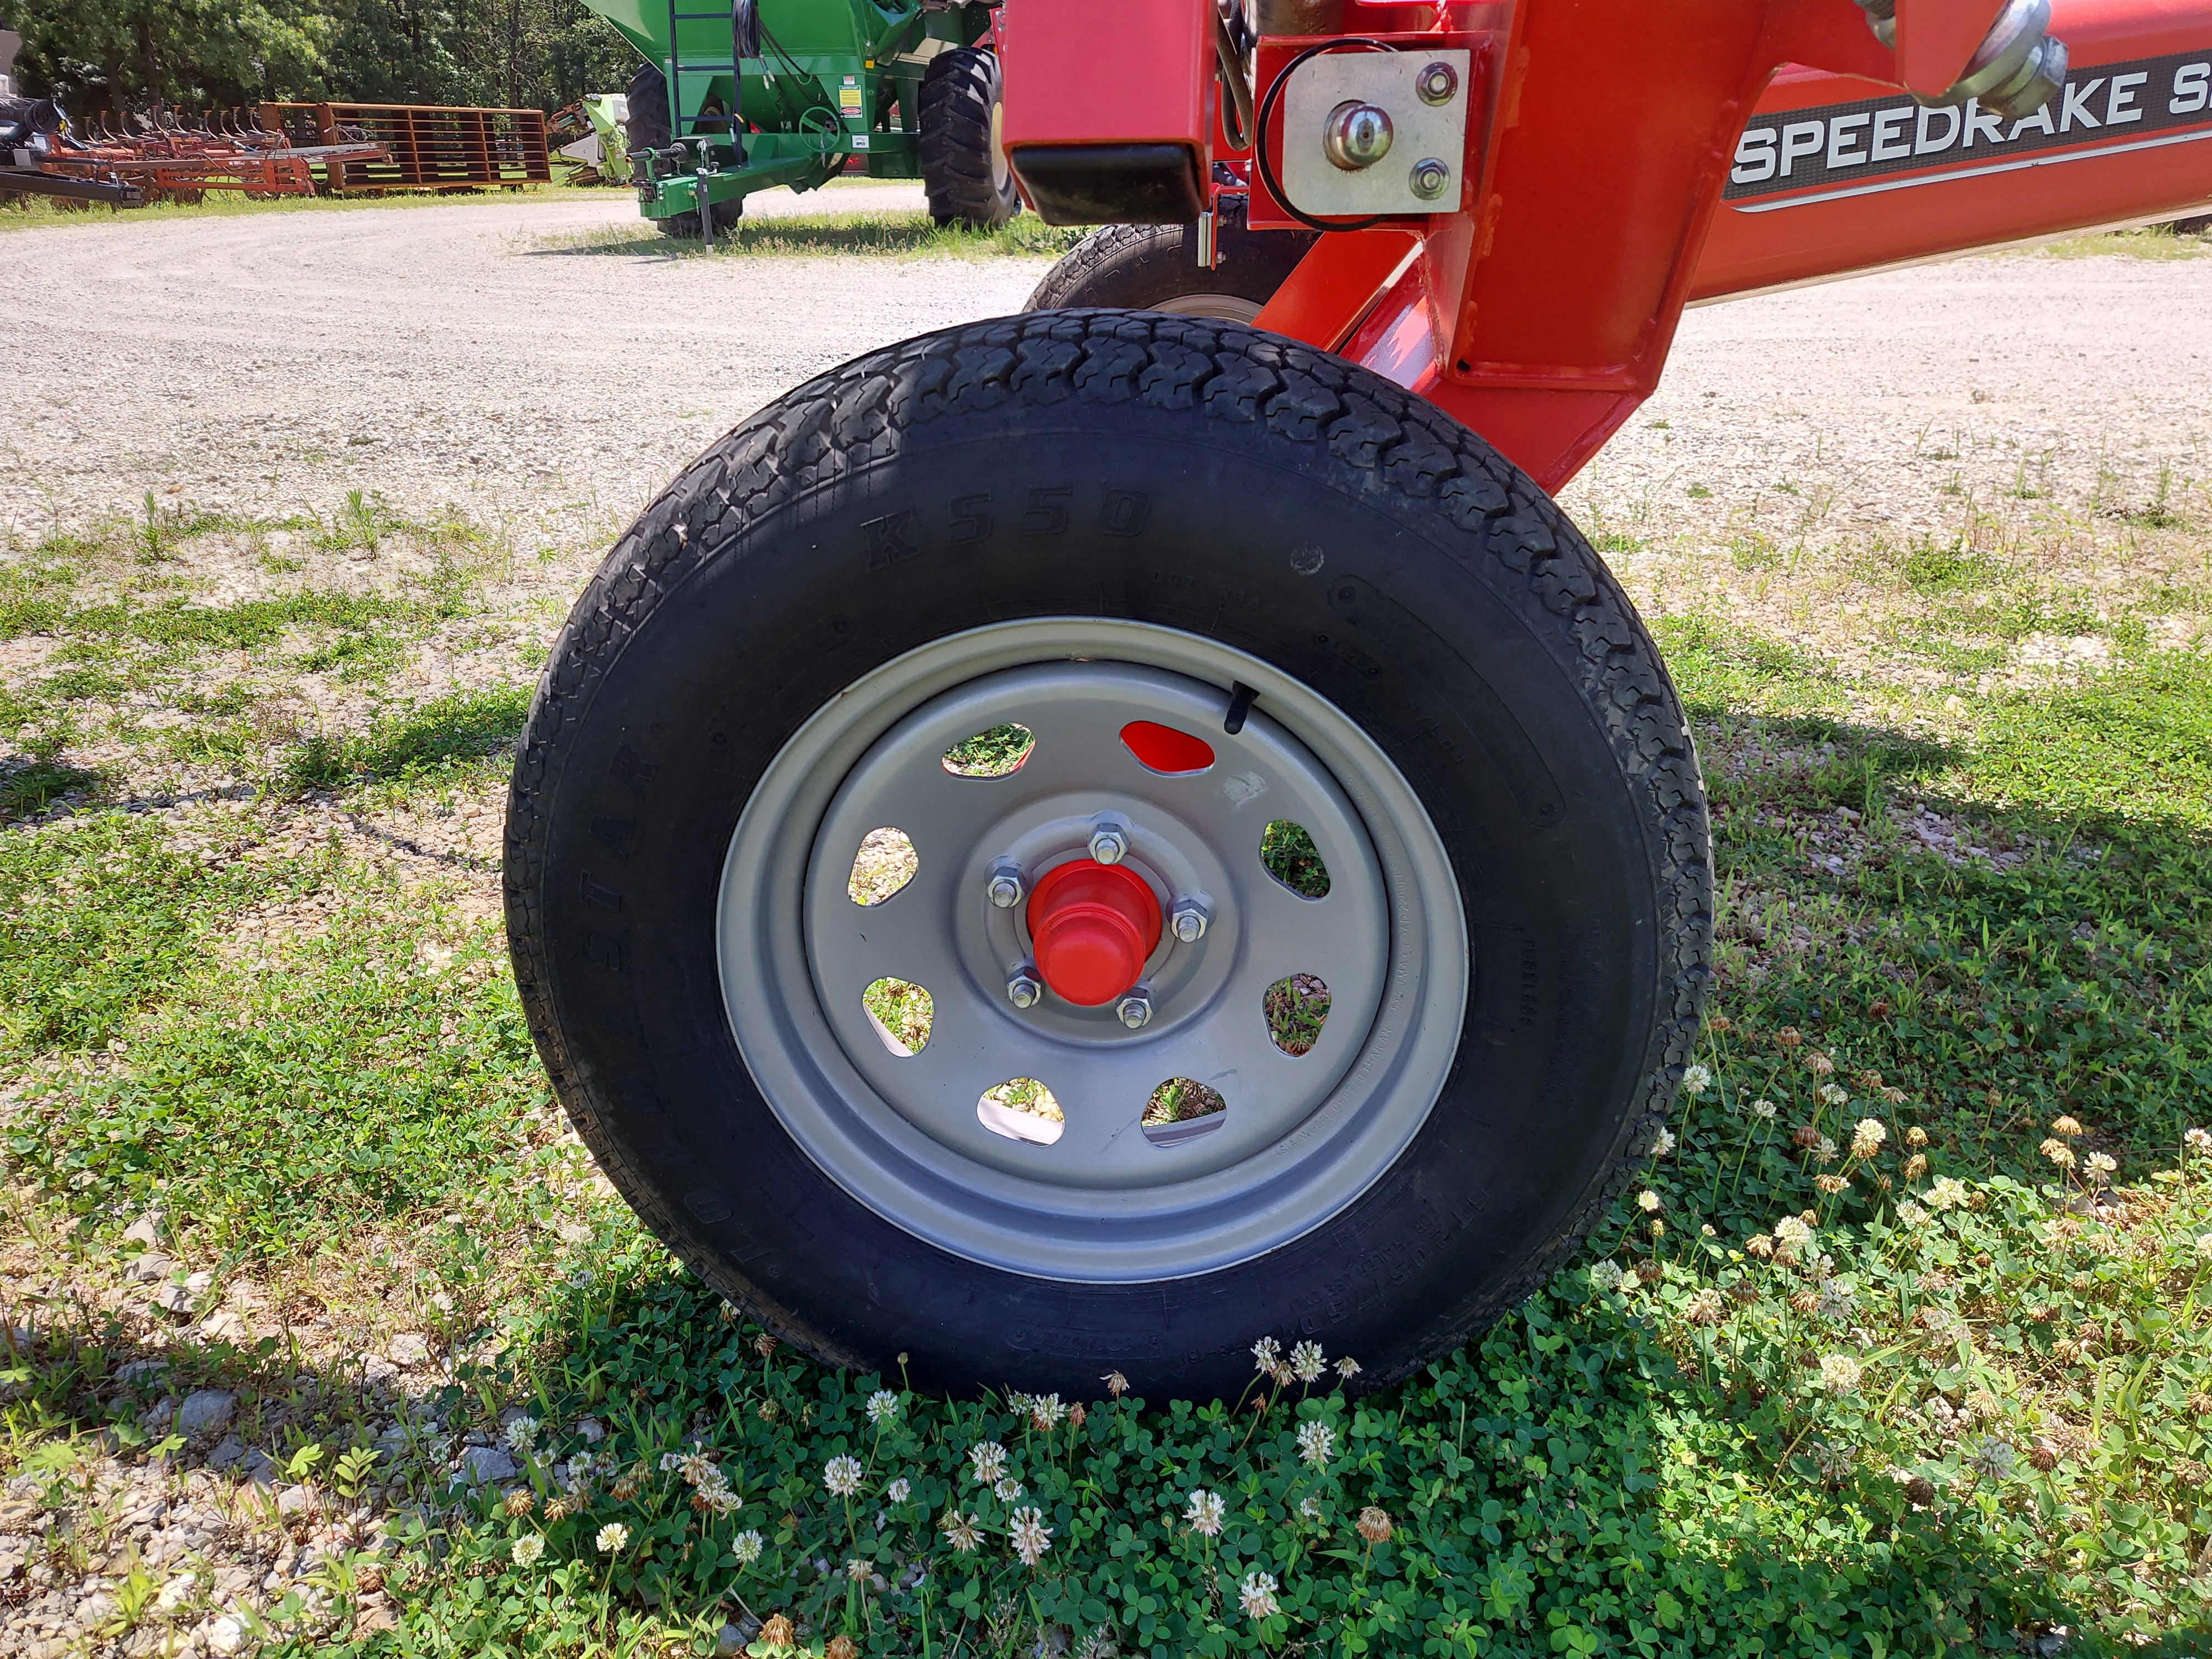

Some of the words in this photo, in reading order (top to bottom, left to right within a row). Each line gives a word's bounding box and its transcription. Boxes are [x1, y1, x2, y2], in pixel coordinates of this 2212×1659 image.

[1731, 71, 2148, 184] SPEEDRAKE
[2169, 62, 2212, 114] S
[859, 486, 1152, 573] K550
[577, 738, 659, 972] STAR
[1520, 935, 1538, 1029] TUBELESS
[1274, 1139, 1300, 1157] ASIA
[1299, 1112, 1333, 1141] WHEEL
[1360, 1020, 1394, 1072] THAILAND
[1399, 915, 1410, 948] LOAD
[1323, 1272, 1357, 1297] USE
[1356, 1234, 1414, 1277] TRAILER
[1287, 1290, 1323, 1314] ONLY
